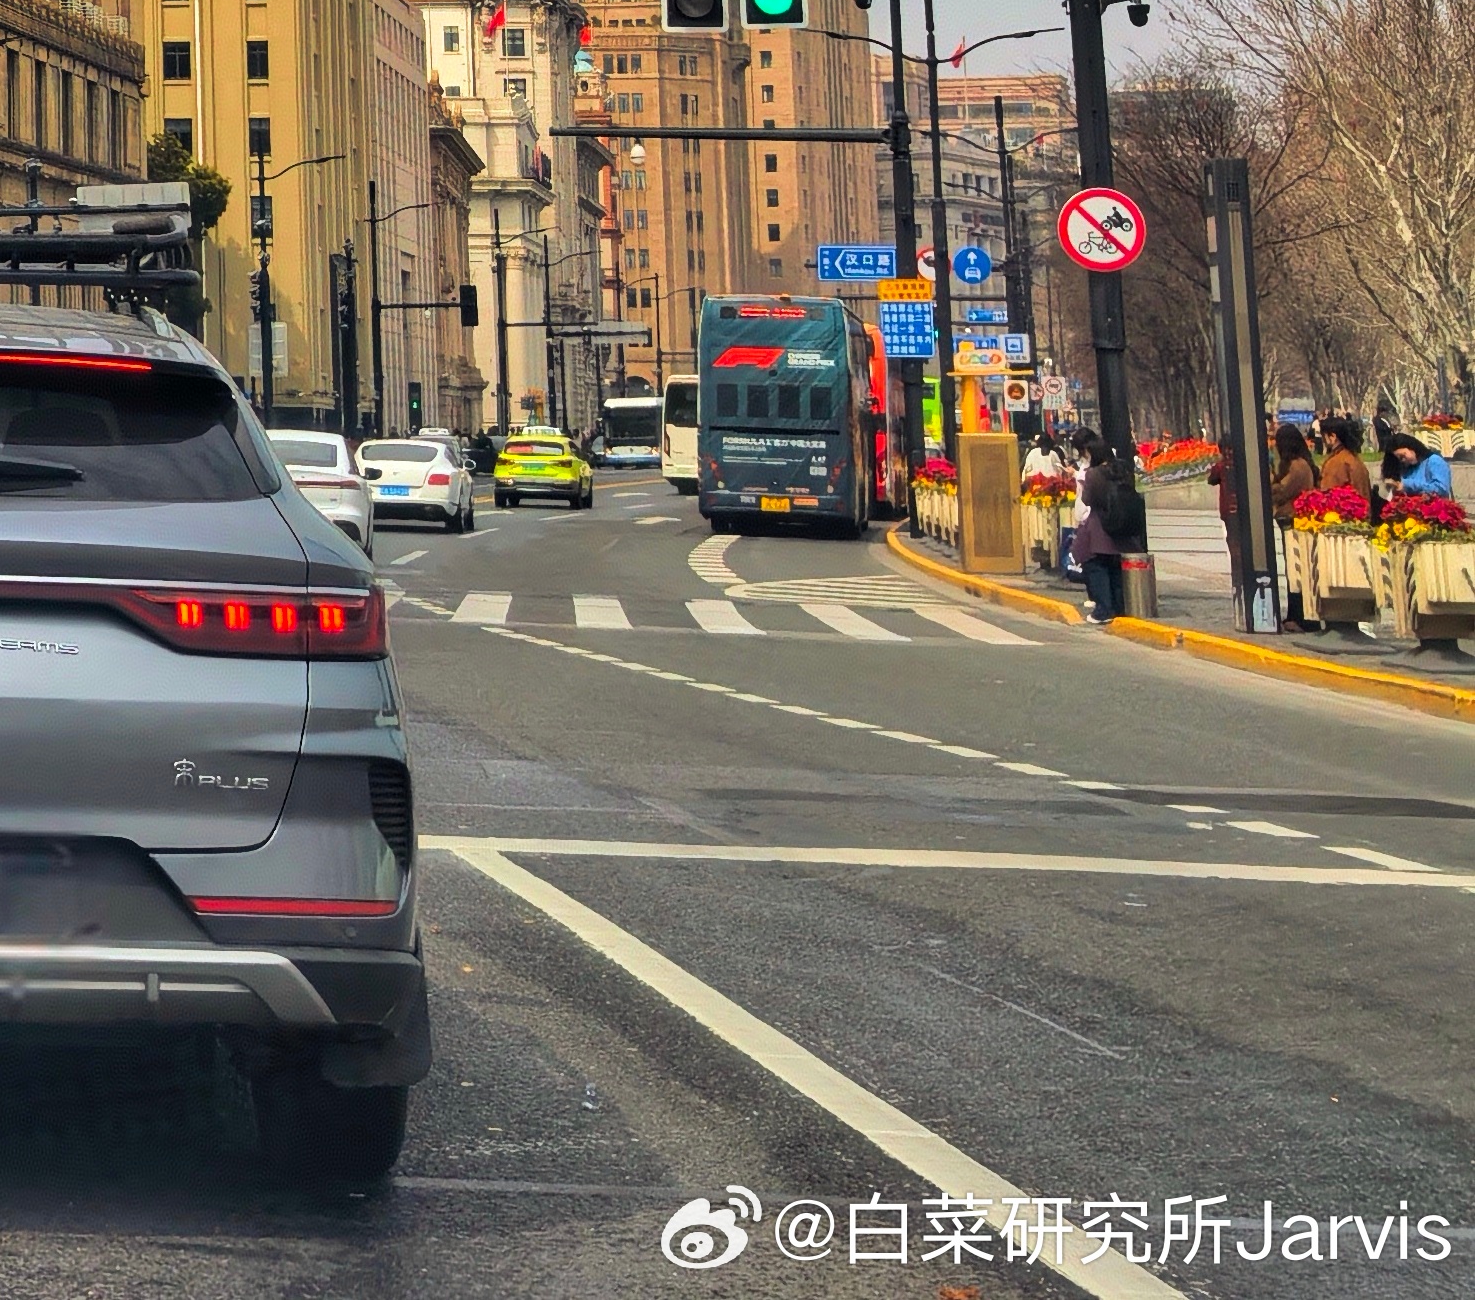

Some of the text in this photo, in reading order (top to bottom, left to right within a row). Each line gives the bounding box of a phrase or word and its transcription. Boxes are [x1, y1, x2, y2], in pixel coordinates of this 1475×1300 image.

[846, 254, 890, 266] 汉口路
[198, 775, 269, 790] PLUS
